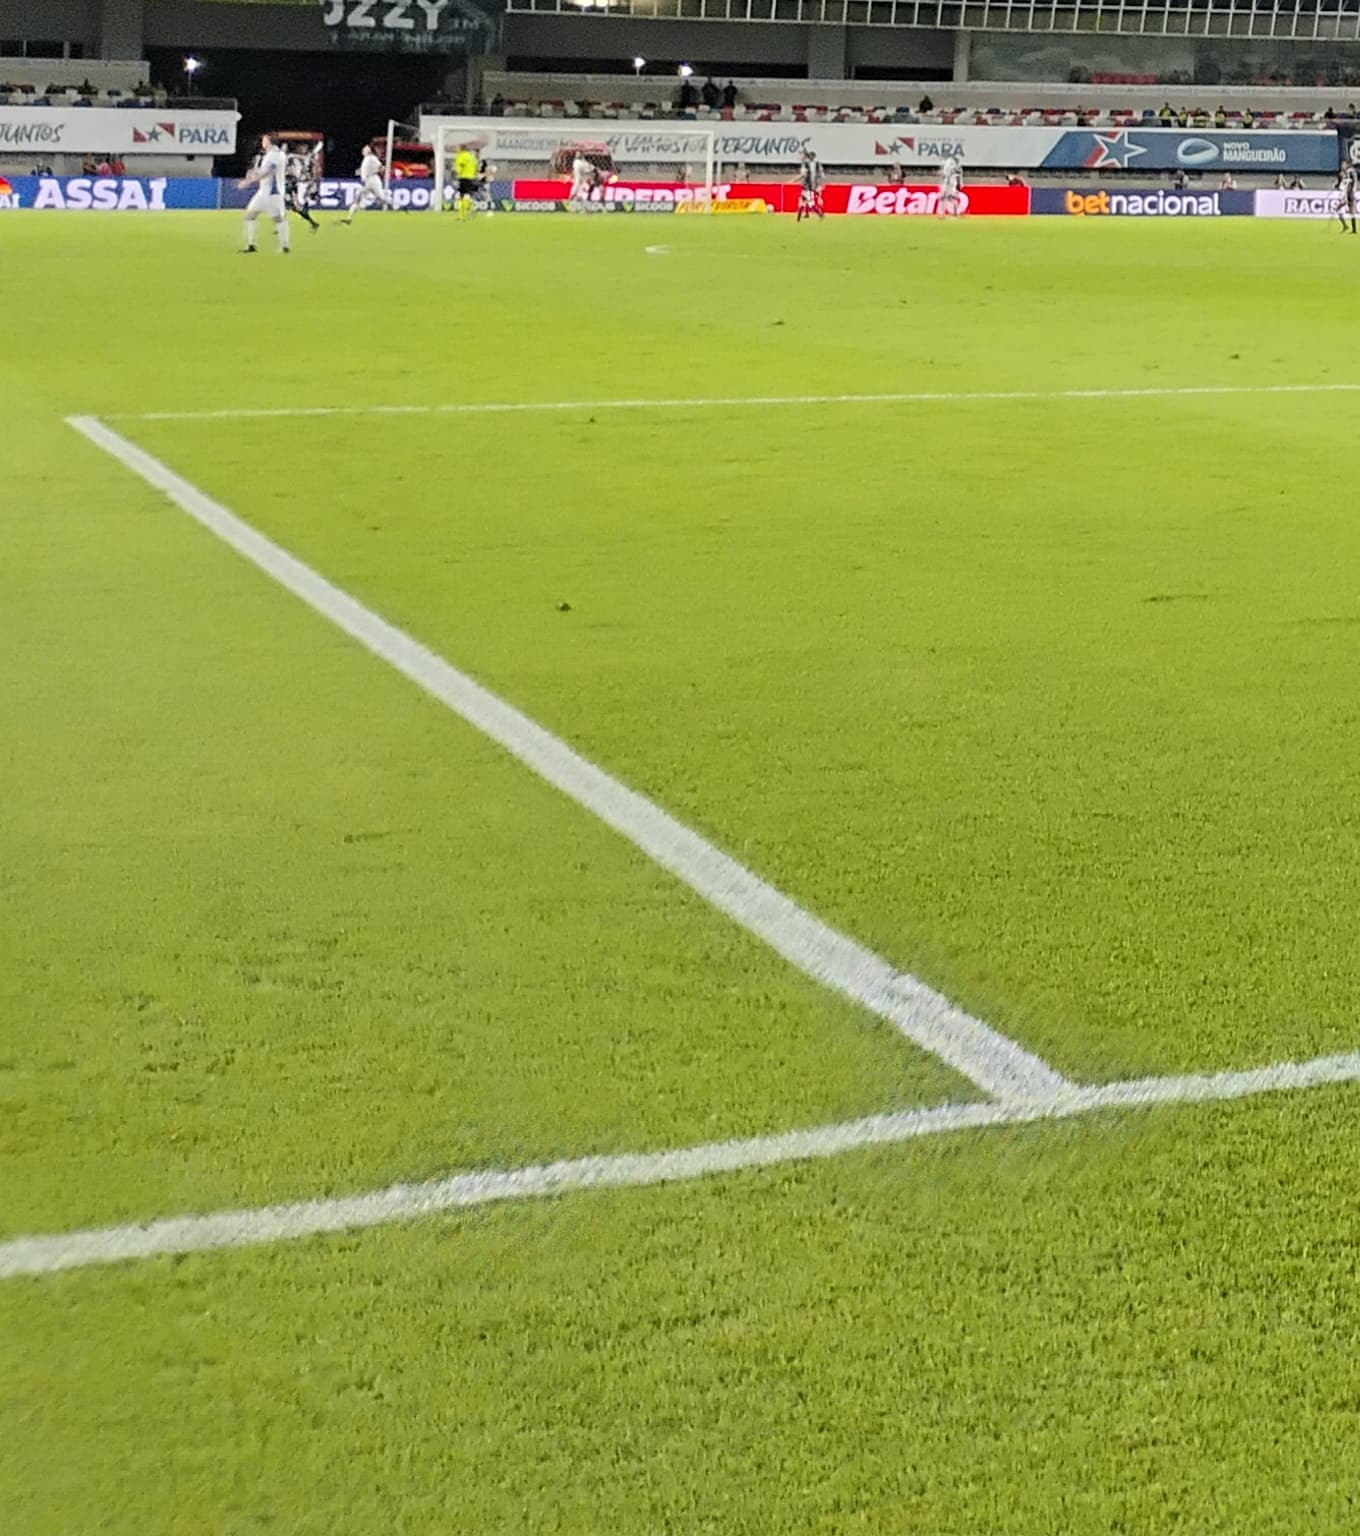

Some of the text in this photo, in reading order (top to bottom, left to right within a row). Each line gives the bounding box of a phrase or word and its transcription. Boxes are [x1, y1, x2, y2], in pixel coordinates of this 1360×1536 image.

[1223, 142, 1250, 151] NOVO
[1223, 147, 1286, 163] MANGUEIRÃO
[1066, 190, 1221, 216] betnacional
